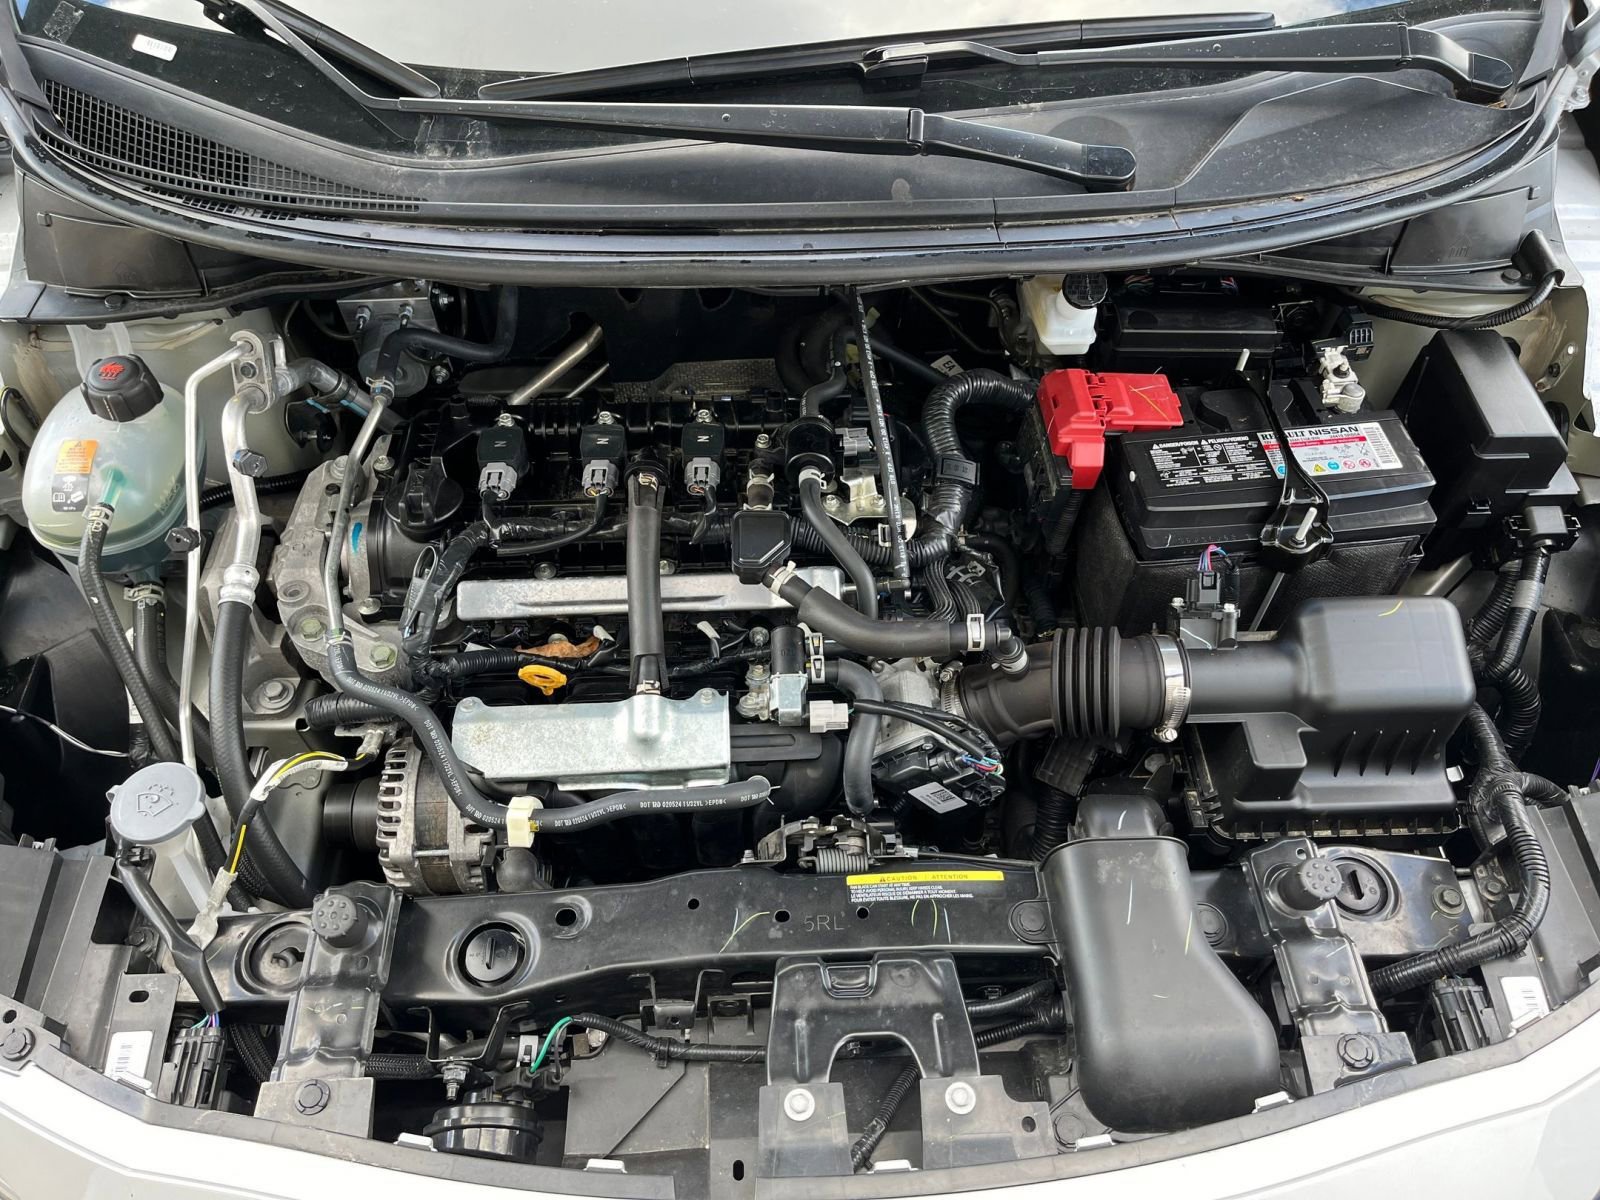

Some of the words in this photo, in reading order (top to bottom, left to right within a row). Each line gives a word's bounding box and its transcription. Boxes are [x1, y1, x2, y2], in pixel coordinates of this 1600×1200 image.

[943, 360, 956, 372] EA
[1260, 430, 1305, 441] REULT
[1309, 426, 1359, 437] NISSAN
[640, 801, 650, 809] DOT
[803, 914, 845, 932] 5RL
